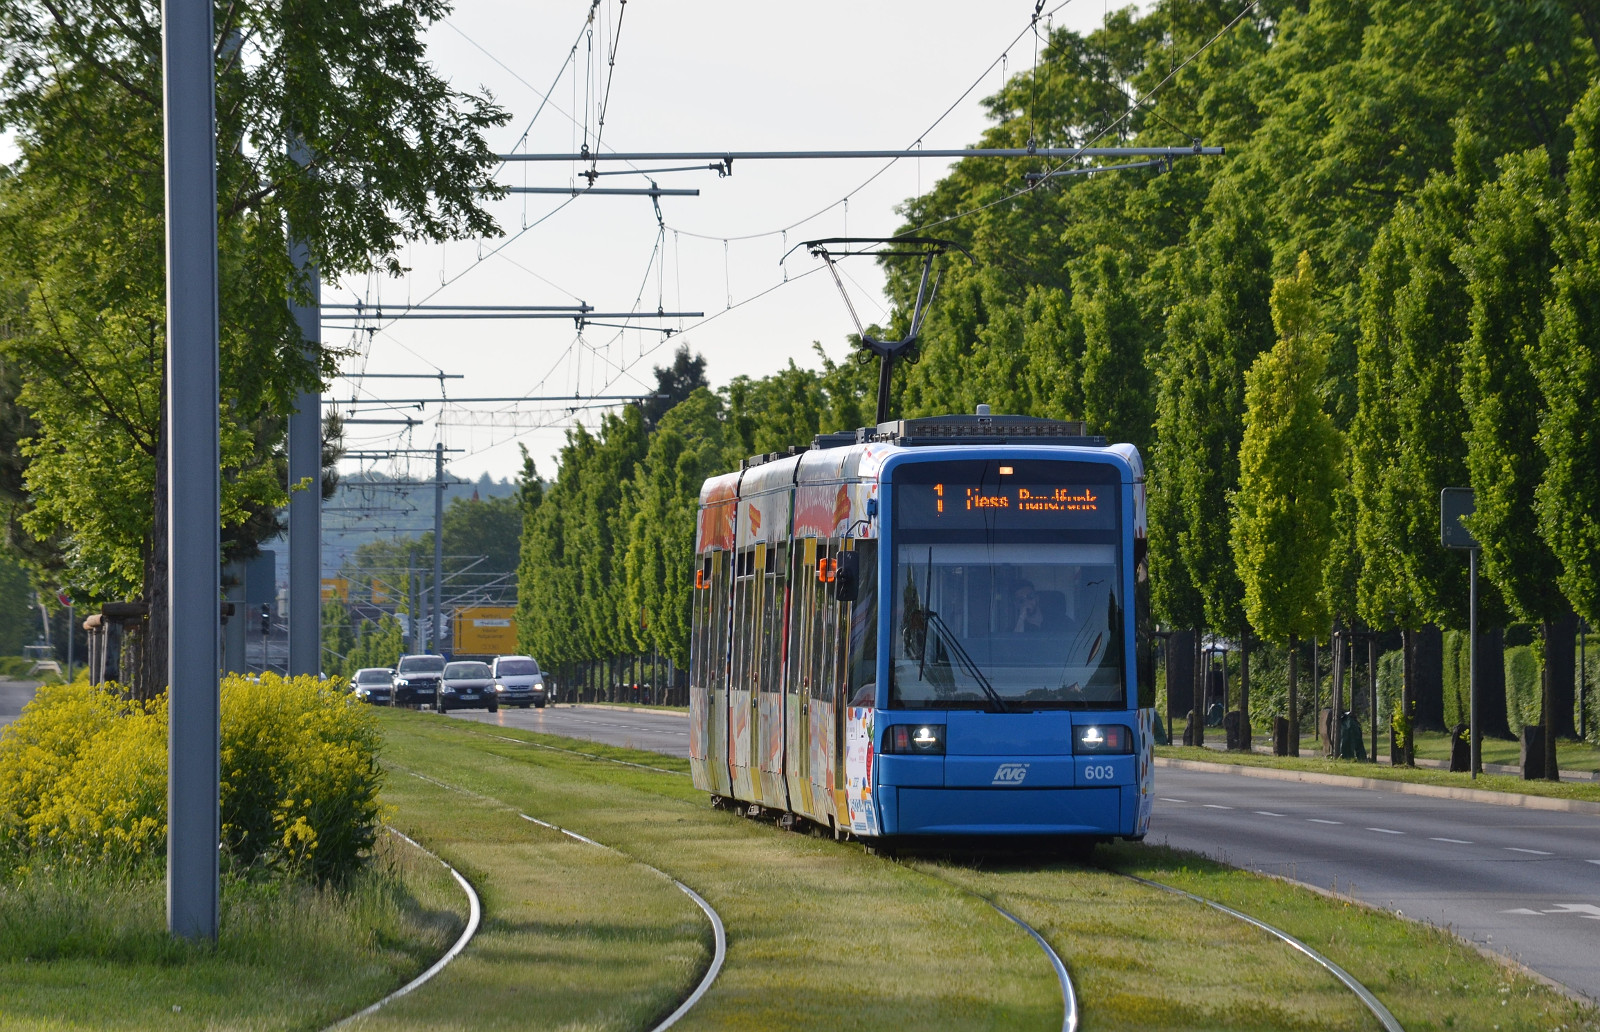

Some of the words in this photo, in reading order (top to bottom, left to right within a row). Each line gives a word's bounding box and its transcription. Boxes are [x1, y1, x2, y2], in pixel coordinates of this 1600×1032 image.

[933, 483, 943, 514] 1
[993, 766, 1027, 782] KVG
[1084, 765, 1114, 780] 603
